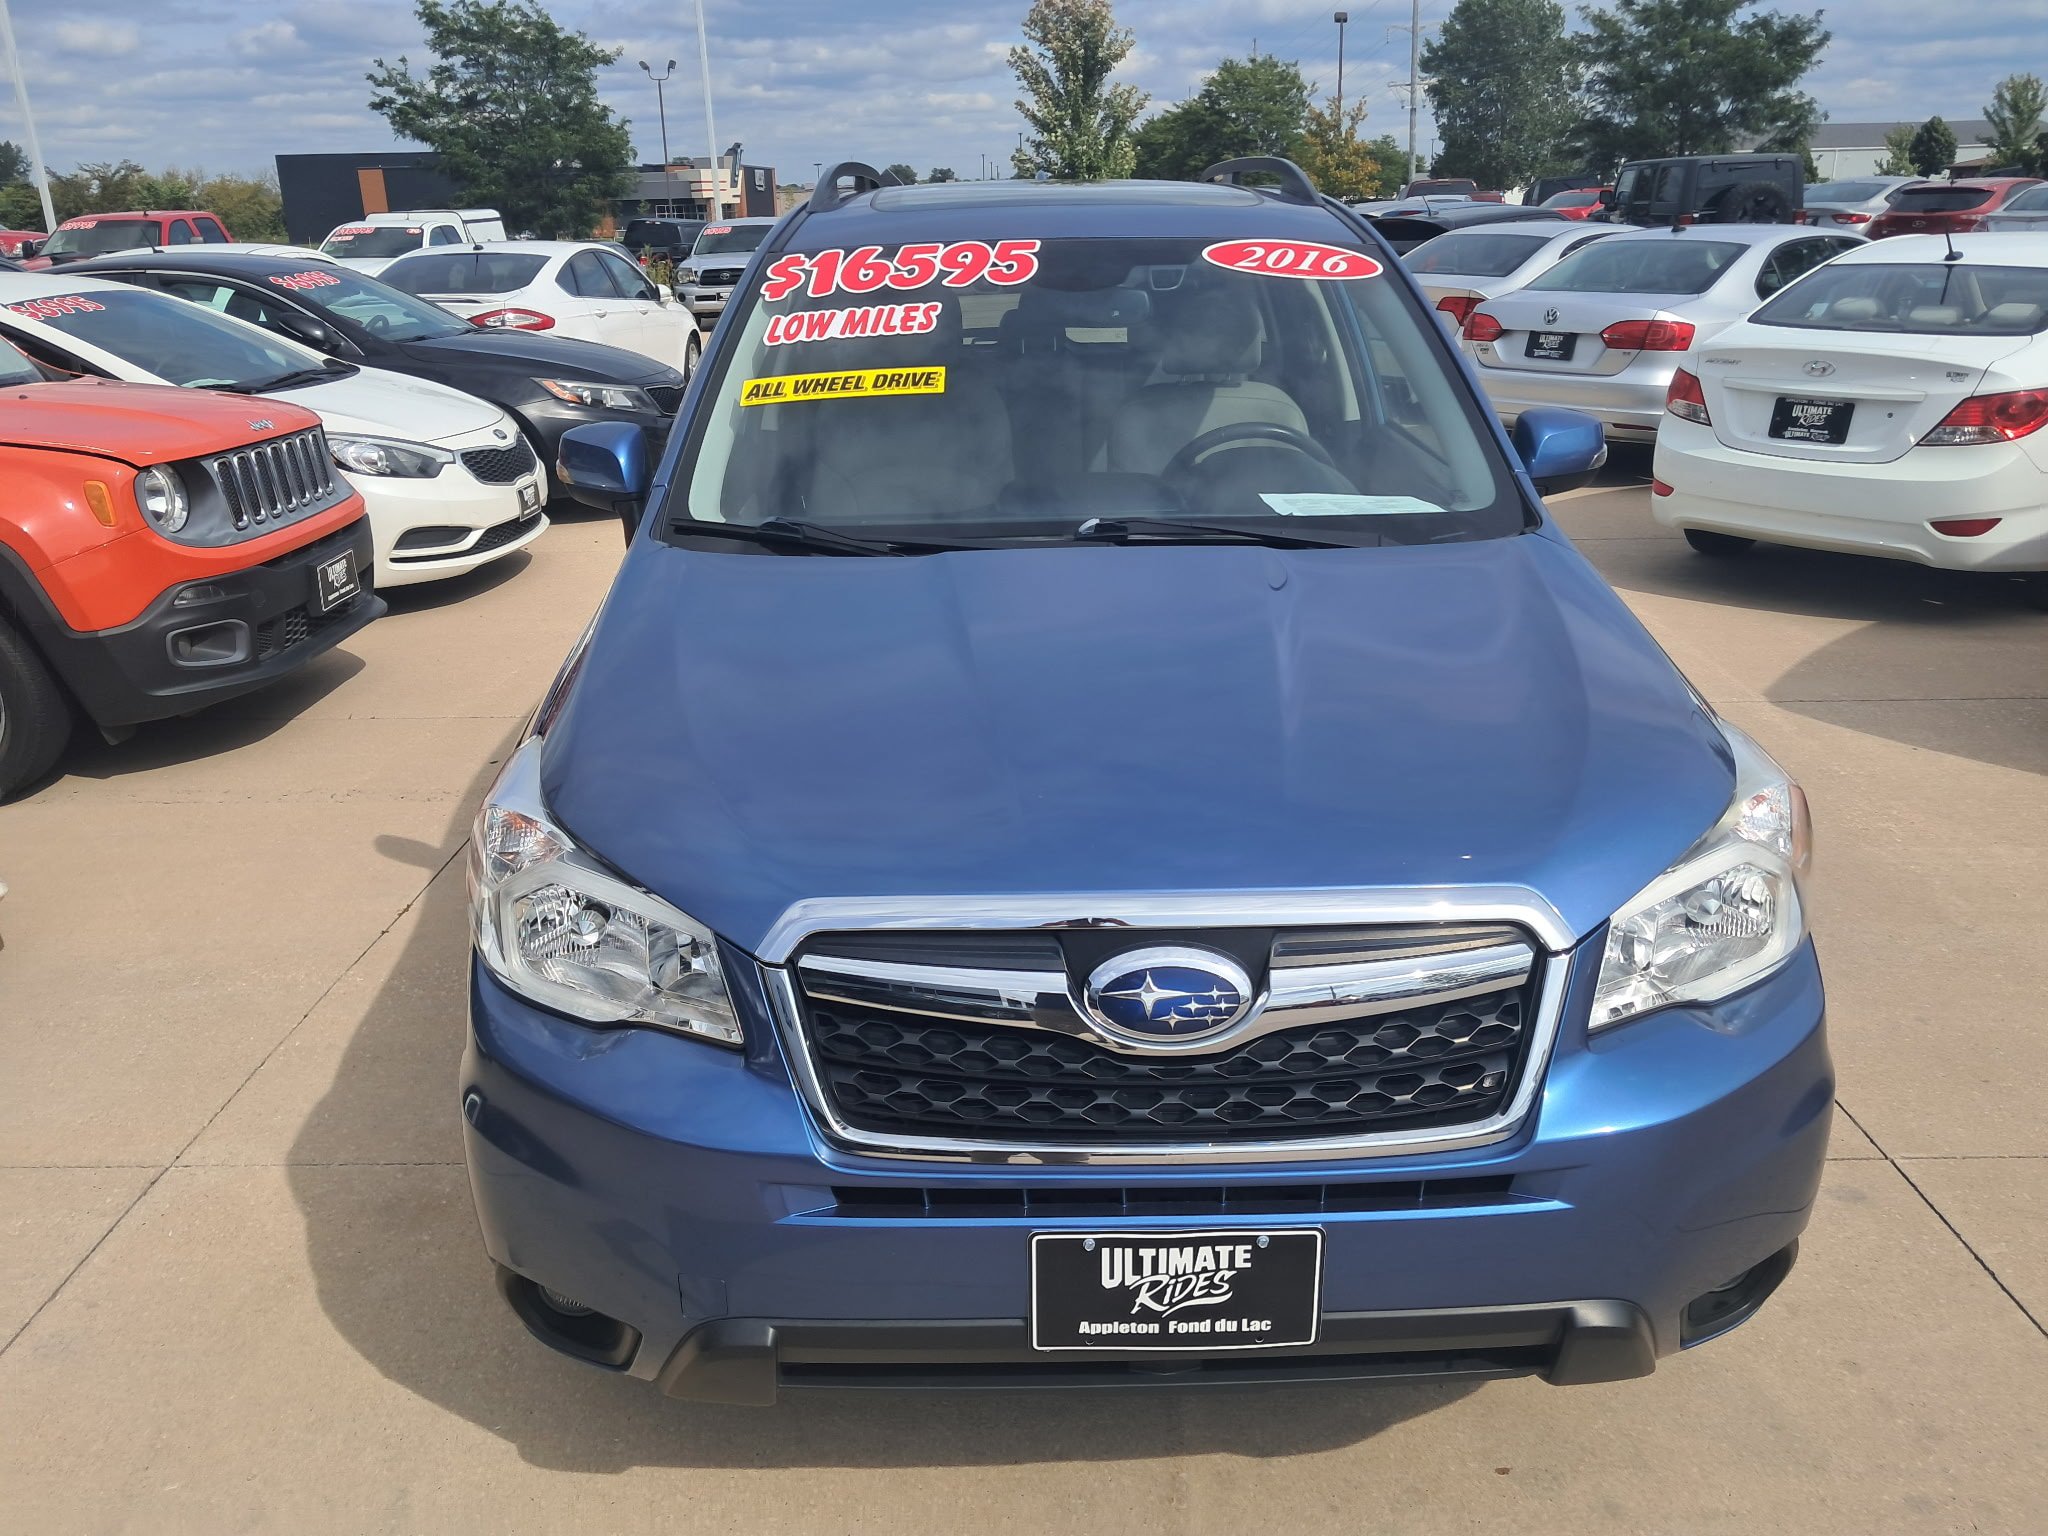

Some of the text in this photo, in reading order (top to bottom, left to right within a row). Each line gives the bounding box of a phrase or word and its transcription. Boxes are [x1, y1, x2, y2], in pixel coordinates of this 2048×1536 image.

[760, 239, 1040, 301] $16595
[1233, 246, 1353, 274] 2016
[268, 270, 341, 290] $6995
[8, 295, 106, 320] $6995
[763, 302, 942, 346] LOW MILES
[744, 370, 942, 400] ALL WHEEL DRIVE
[1792, 404, 1833, 418] ULTIMATE
[1101, 1245, 1253, 1289] ULTIMATE
[1078, 1318, 1272, 1335] Appleton Fond du Lac
